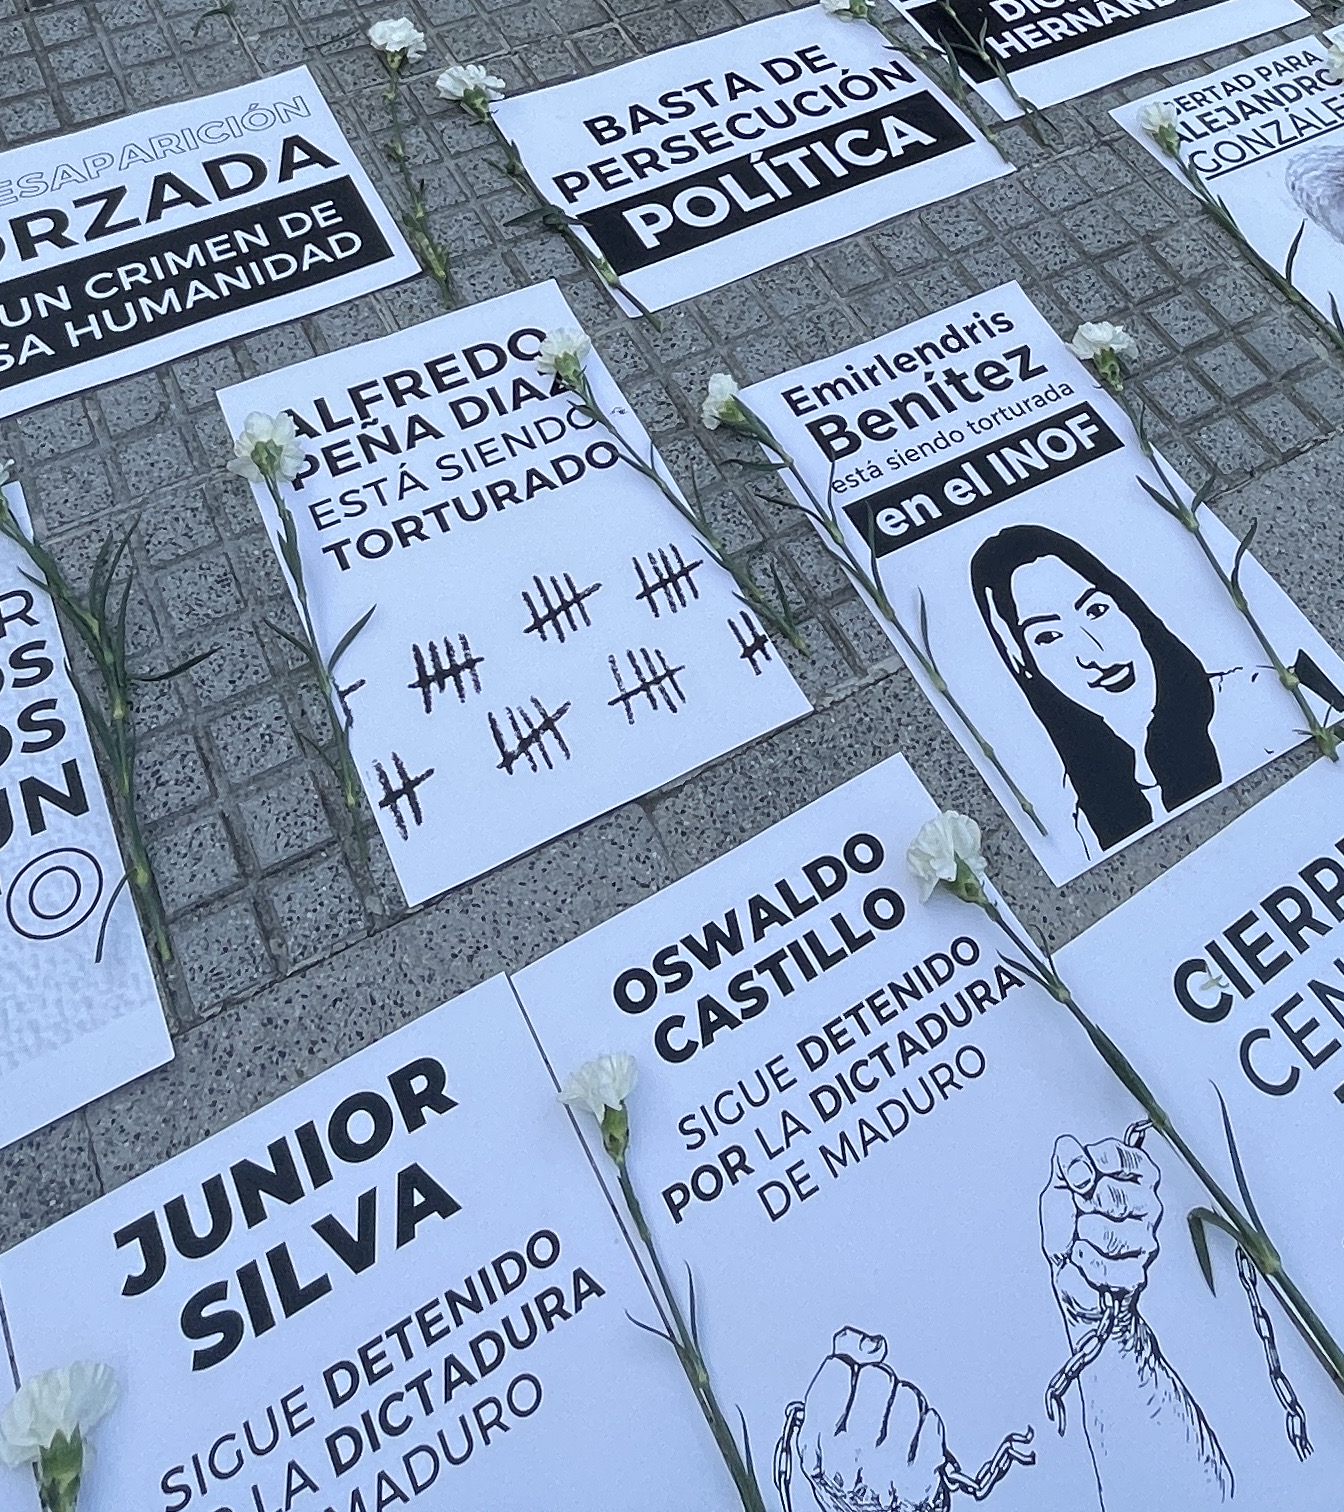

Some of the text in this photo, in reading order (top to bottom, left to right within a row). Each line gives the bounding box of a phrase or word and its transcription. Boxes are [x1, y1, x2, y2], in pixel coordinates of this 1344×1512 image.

[550, 58, 920, 205] PERSECUCIÓN
[584, 43, 839, 148] BASTA DE
[1254, 50, 1324, 81] PARA
[83, 225, 272, 302] CRIMEN
[283, 200, 346, 241] DE
[621, 114, 941, 253] POLÍTICA
[64, 229, 365, 351] HUMANIDAD
[780, 307, 1015, 418] Emirlendris
[804, 343, 1049, 464] Benítez
[311, 405, 596, 532] ESTÁ SIENDO
[322, 440, 620, 573] TORTURADO
[830, 379, 1076, 495] está siendo torturada
[874, 410, 1102, 538] en el INOF
[611, 830, 887, 1016] OSWALDO
[653, 887, 909, 1067] CASTILLO
[661, 964, 1026, 1226] POR LA DICTADURA
[677, 934, 984, 1153] SIGUE DETENIDO
[112, 1054, 460, 1299] JUNIOR
[759, 1042, 989, 1224] DE MADURO
[178, 1161, 464, 1373] SILVA
[160, 1228, 561, 1512] SIGUE DETENIDO
[324, 1267, 607, 1478] DICTADURA
